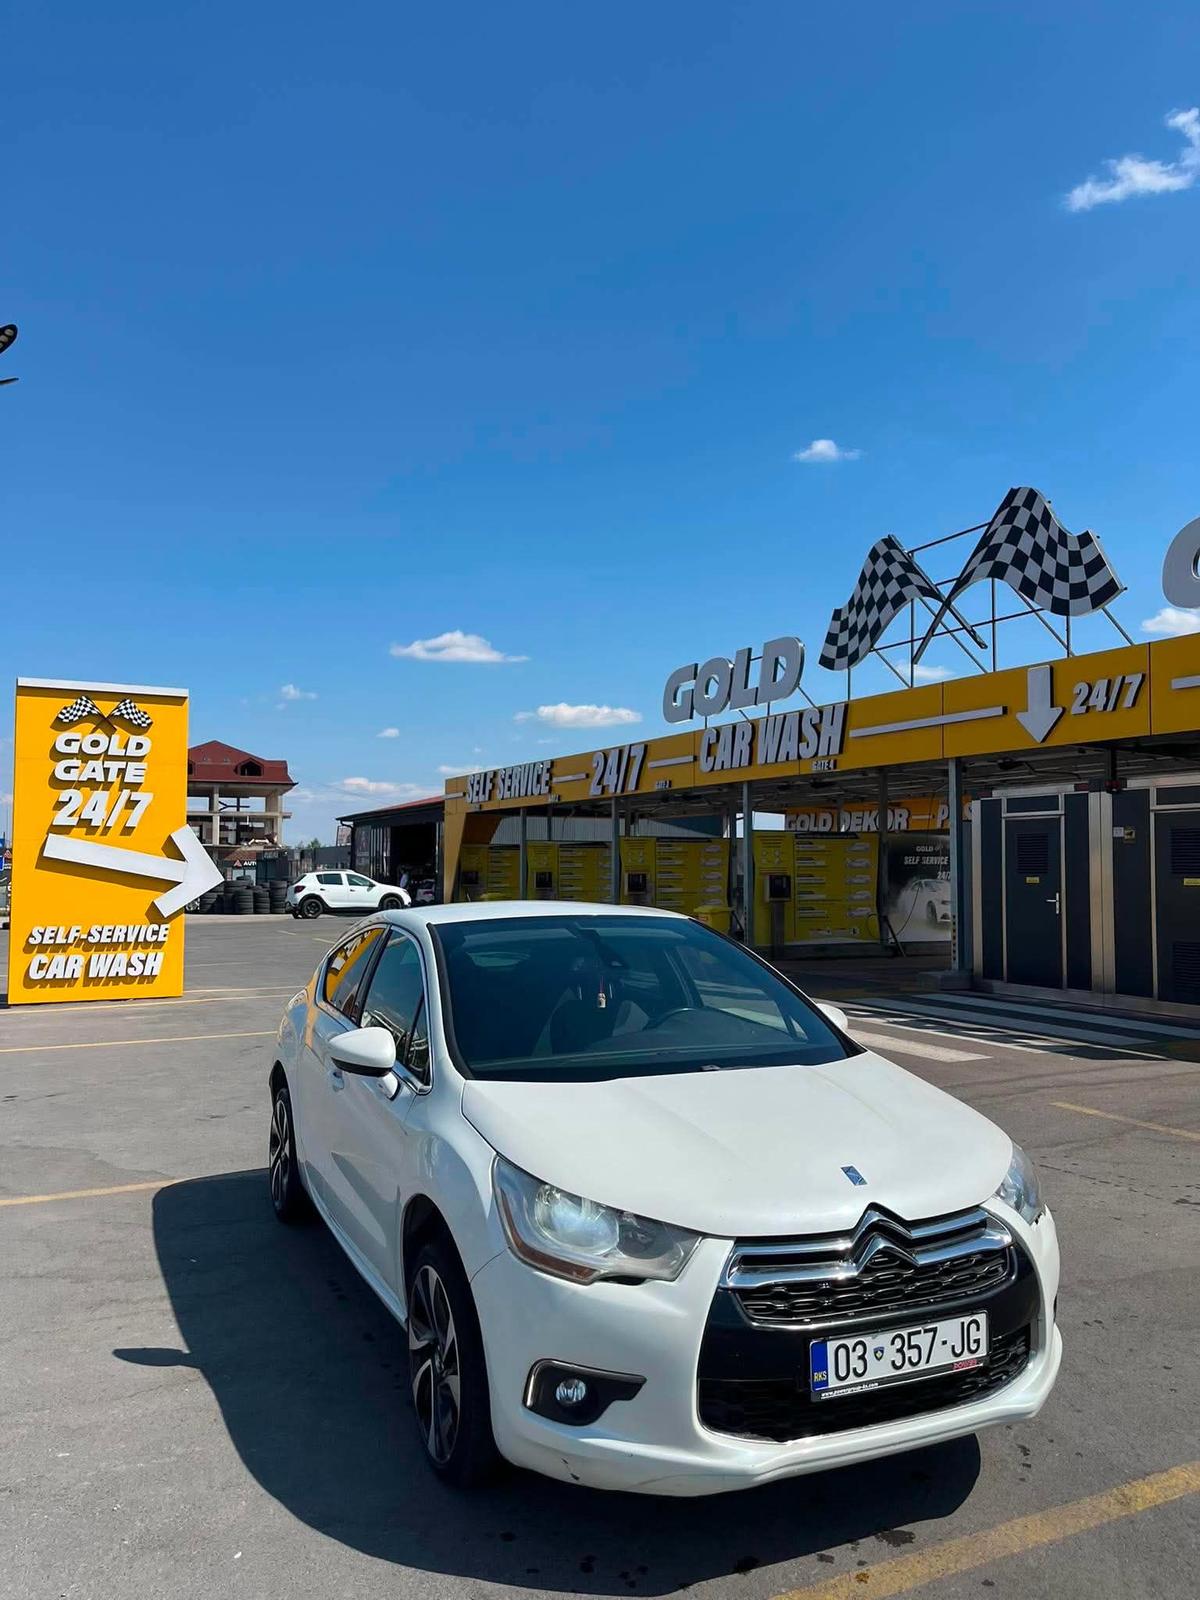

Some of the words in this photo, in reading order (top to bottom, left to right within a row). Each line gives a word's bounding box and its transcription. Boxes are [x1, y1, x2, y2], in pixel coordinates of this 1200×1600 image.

[663, 636, 806, 724] GOLD
[1071, 672, 1144, 715] 24/7
[54, 732, 153, 757] GOLD
[701, 721, 753, 773] CAR
[757, 703, 848, 765] WASH
[54, 759, 148, 783] GATE
[466, 771, 494, 804] SELF
[498, 761, 552, 800] SERVICE
[589, 744, 648, 796] 24/7
[52, 789, 154, 828] 24/7
[784, 811, 833, 832] GOLD
[839, 807, 910, 833] DEKOR
[903, 856, 920, 865] SELF
[921, 856, 949, 865] SERVICE
[28, 923, 170, 945] SELF-SERVICE
[28, 953, 85, 980] CAR
[88, 951, 164, 978] WASH
[813, 1370, 828, 1382] RKS
[834, 1339, 868, 1381] 03
